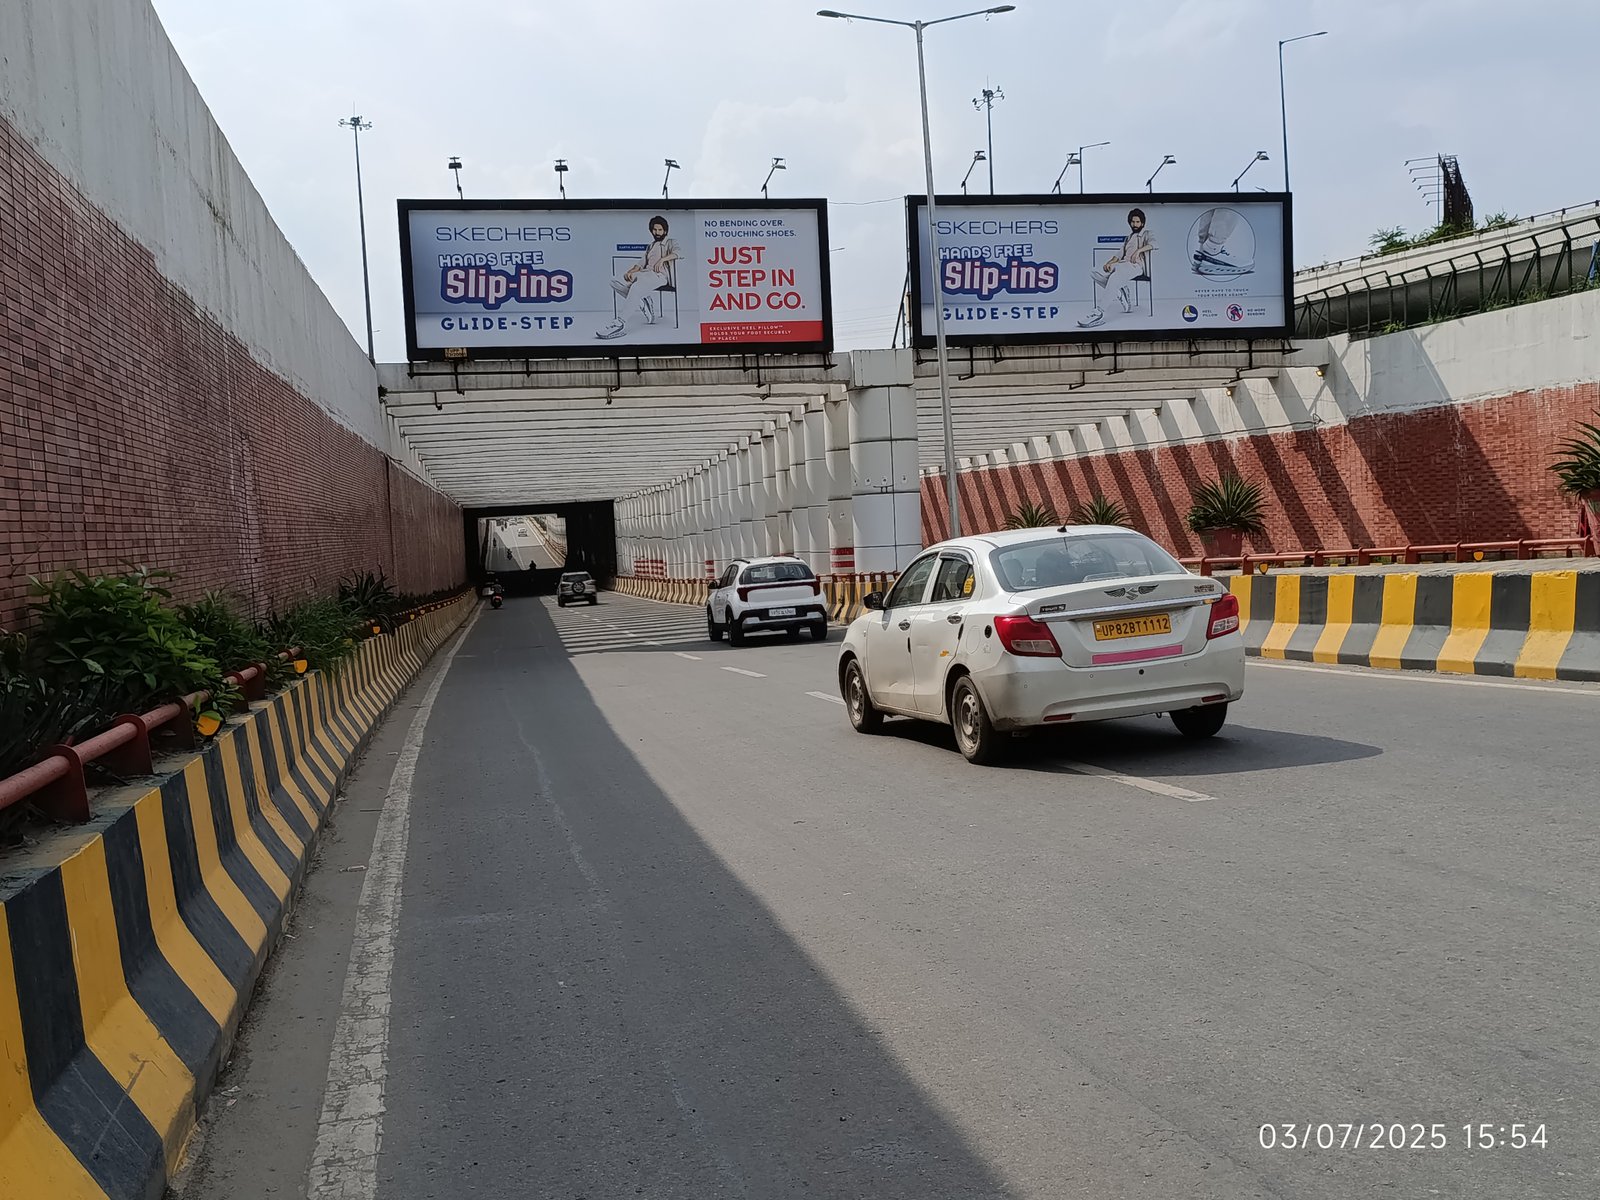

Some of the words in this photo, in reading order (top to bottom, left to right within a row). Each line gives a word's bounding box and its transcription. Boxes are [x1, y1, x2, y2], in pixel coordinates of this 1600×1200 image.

[760, 219, 785, 227] OVER.
[937, 221, 1058, 235] SKECHERS
[436, 227, 571, 241] SKECHERS
[766, 229, 797, 237] SHOES.
[438, 253, 498, 268] HANDS
[501, 251, 544, 266] FREE
[707, 246, 766, 265] JUST
[939, 246, 991, 261] HANDS
[994, 244, 1033, 259] FREE
[444, 267, 570, 306] Slip-ins
[709, 269, 766, 288] STEP
[771, 269, 795, 287] IN
[944, 260, 1055, 296] Slip-ins
[709, 293, 762, 311] AND
[766, 291, 806, 310] GO.
[943, 307, 1059, 320] GLIDE-STEP
[440, 316, 573, 330] GLIDE-STEP
[1101, 617, 1169, 636] UP82BT1112
